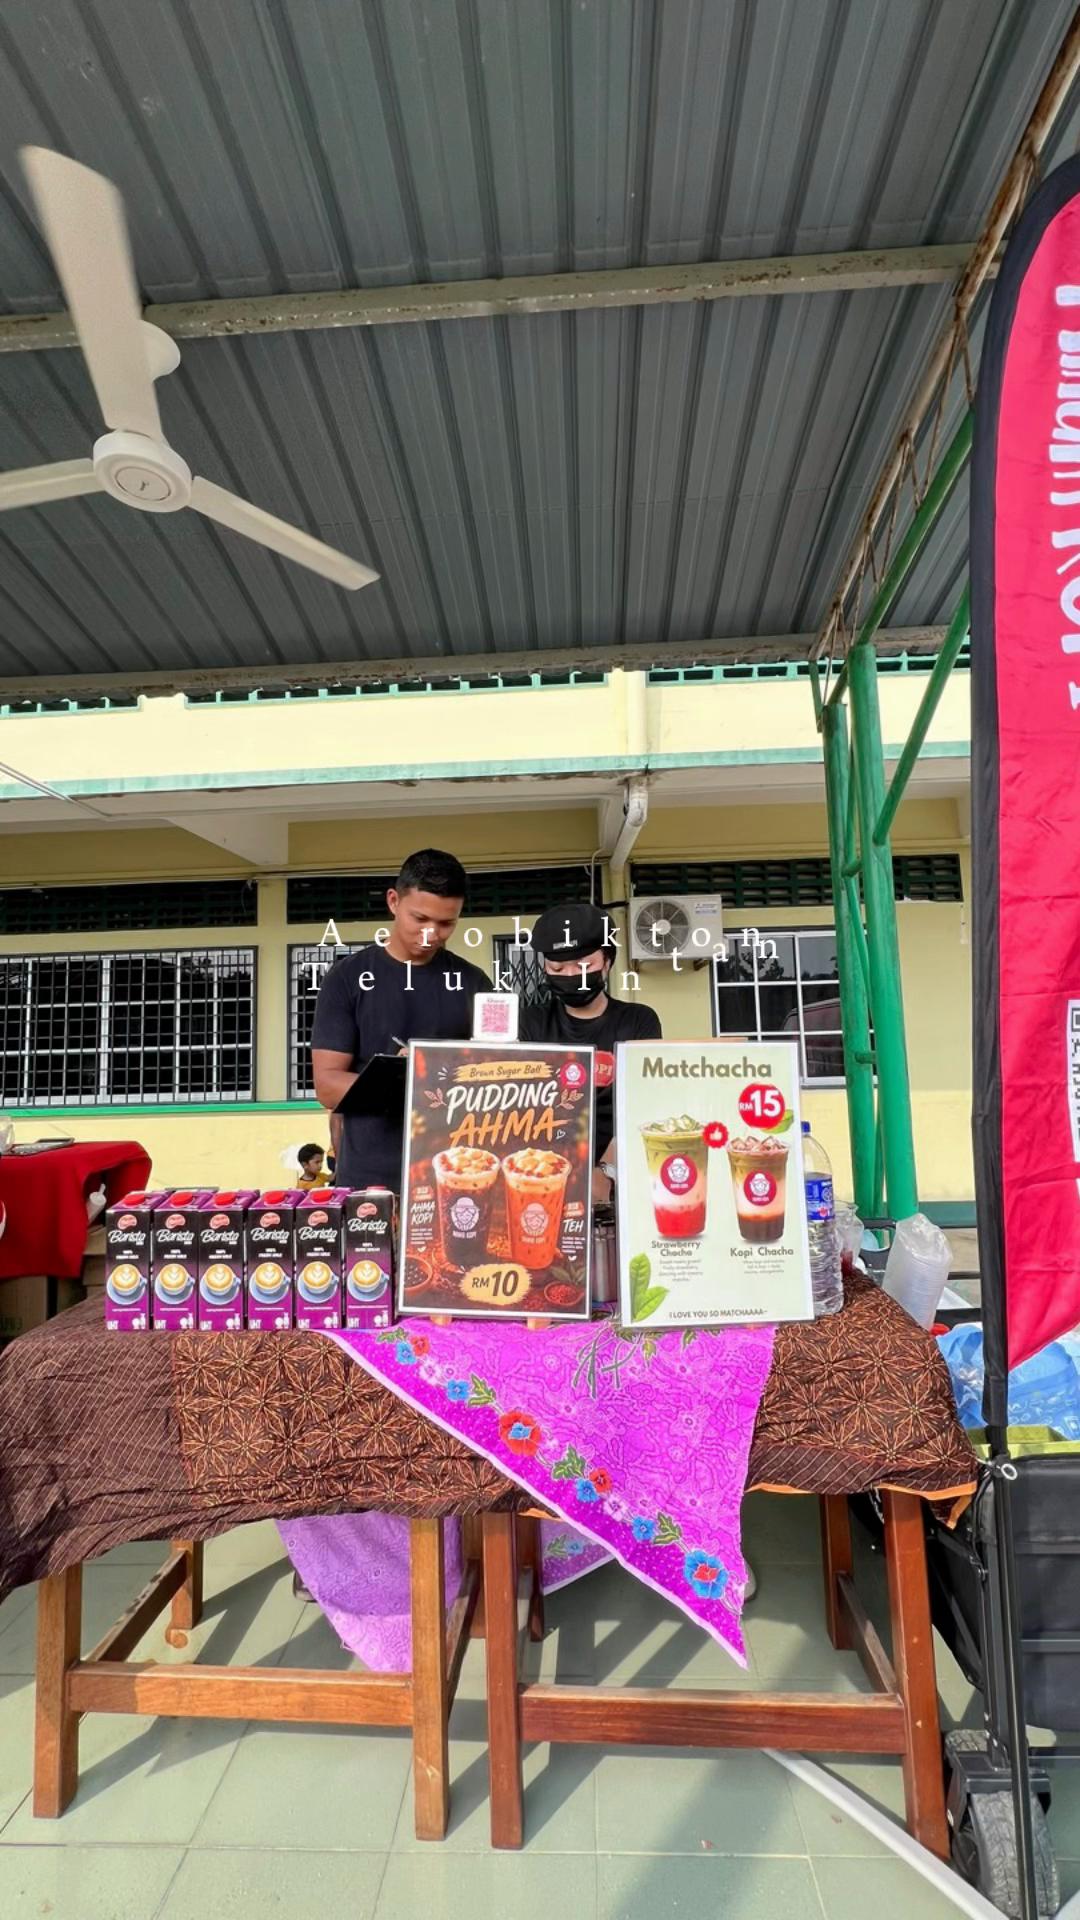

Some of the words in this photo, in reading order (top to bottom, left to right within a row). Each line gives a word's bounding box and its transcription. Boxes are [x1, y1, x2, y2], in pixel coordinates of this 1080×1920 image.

[470, 1067, 494, 1078] Brown
[496, 1066, 521, 1078] Sugar
[523, 1064, 542, 1075] Ball
[642, 1056, 772, 1079] Matchacha
[446, 1080, 557, 1124] PUDDING
[450, 1108, 573, 1147] AHMA
[410, 1201, 436, 1213] AHMA
[347, 1218, 388, 1232] Barista
[410, 1212, 434, 1225] KOPI
[563, 1218, 584, 1233] TEH
[108, 1230, 146, 1244] Barista
[156, 1229, 195, 1242] Barista
[200, 1230, 239, 1243] Barista
[251, 1228, 290, 1242] Barista
[299, 1227, 338, 1241] Barista
[651, 1240, 701, 1249] Strawberry
[660, 1248, 692, 1257] Chacha
[730, 1247, 753, 1259] Kopi
[757, 1246, 794, 1257] Chacha
[673, 1311, 692, 1319] LOVE
[693, 1310, 708, 1318] YOU
